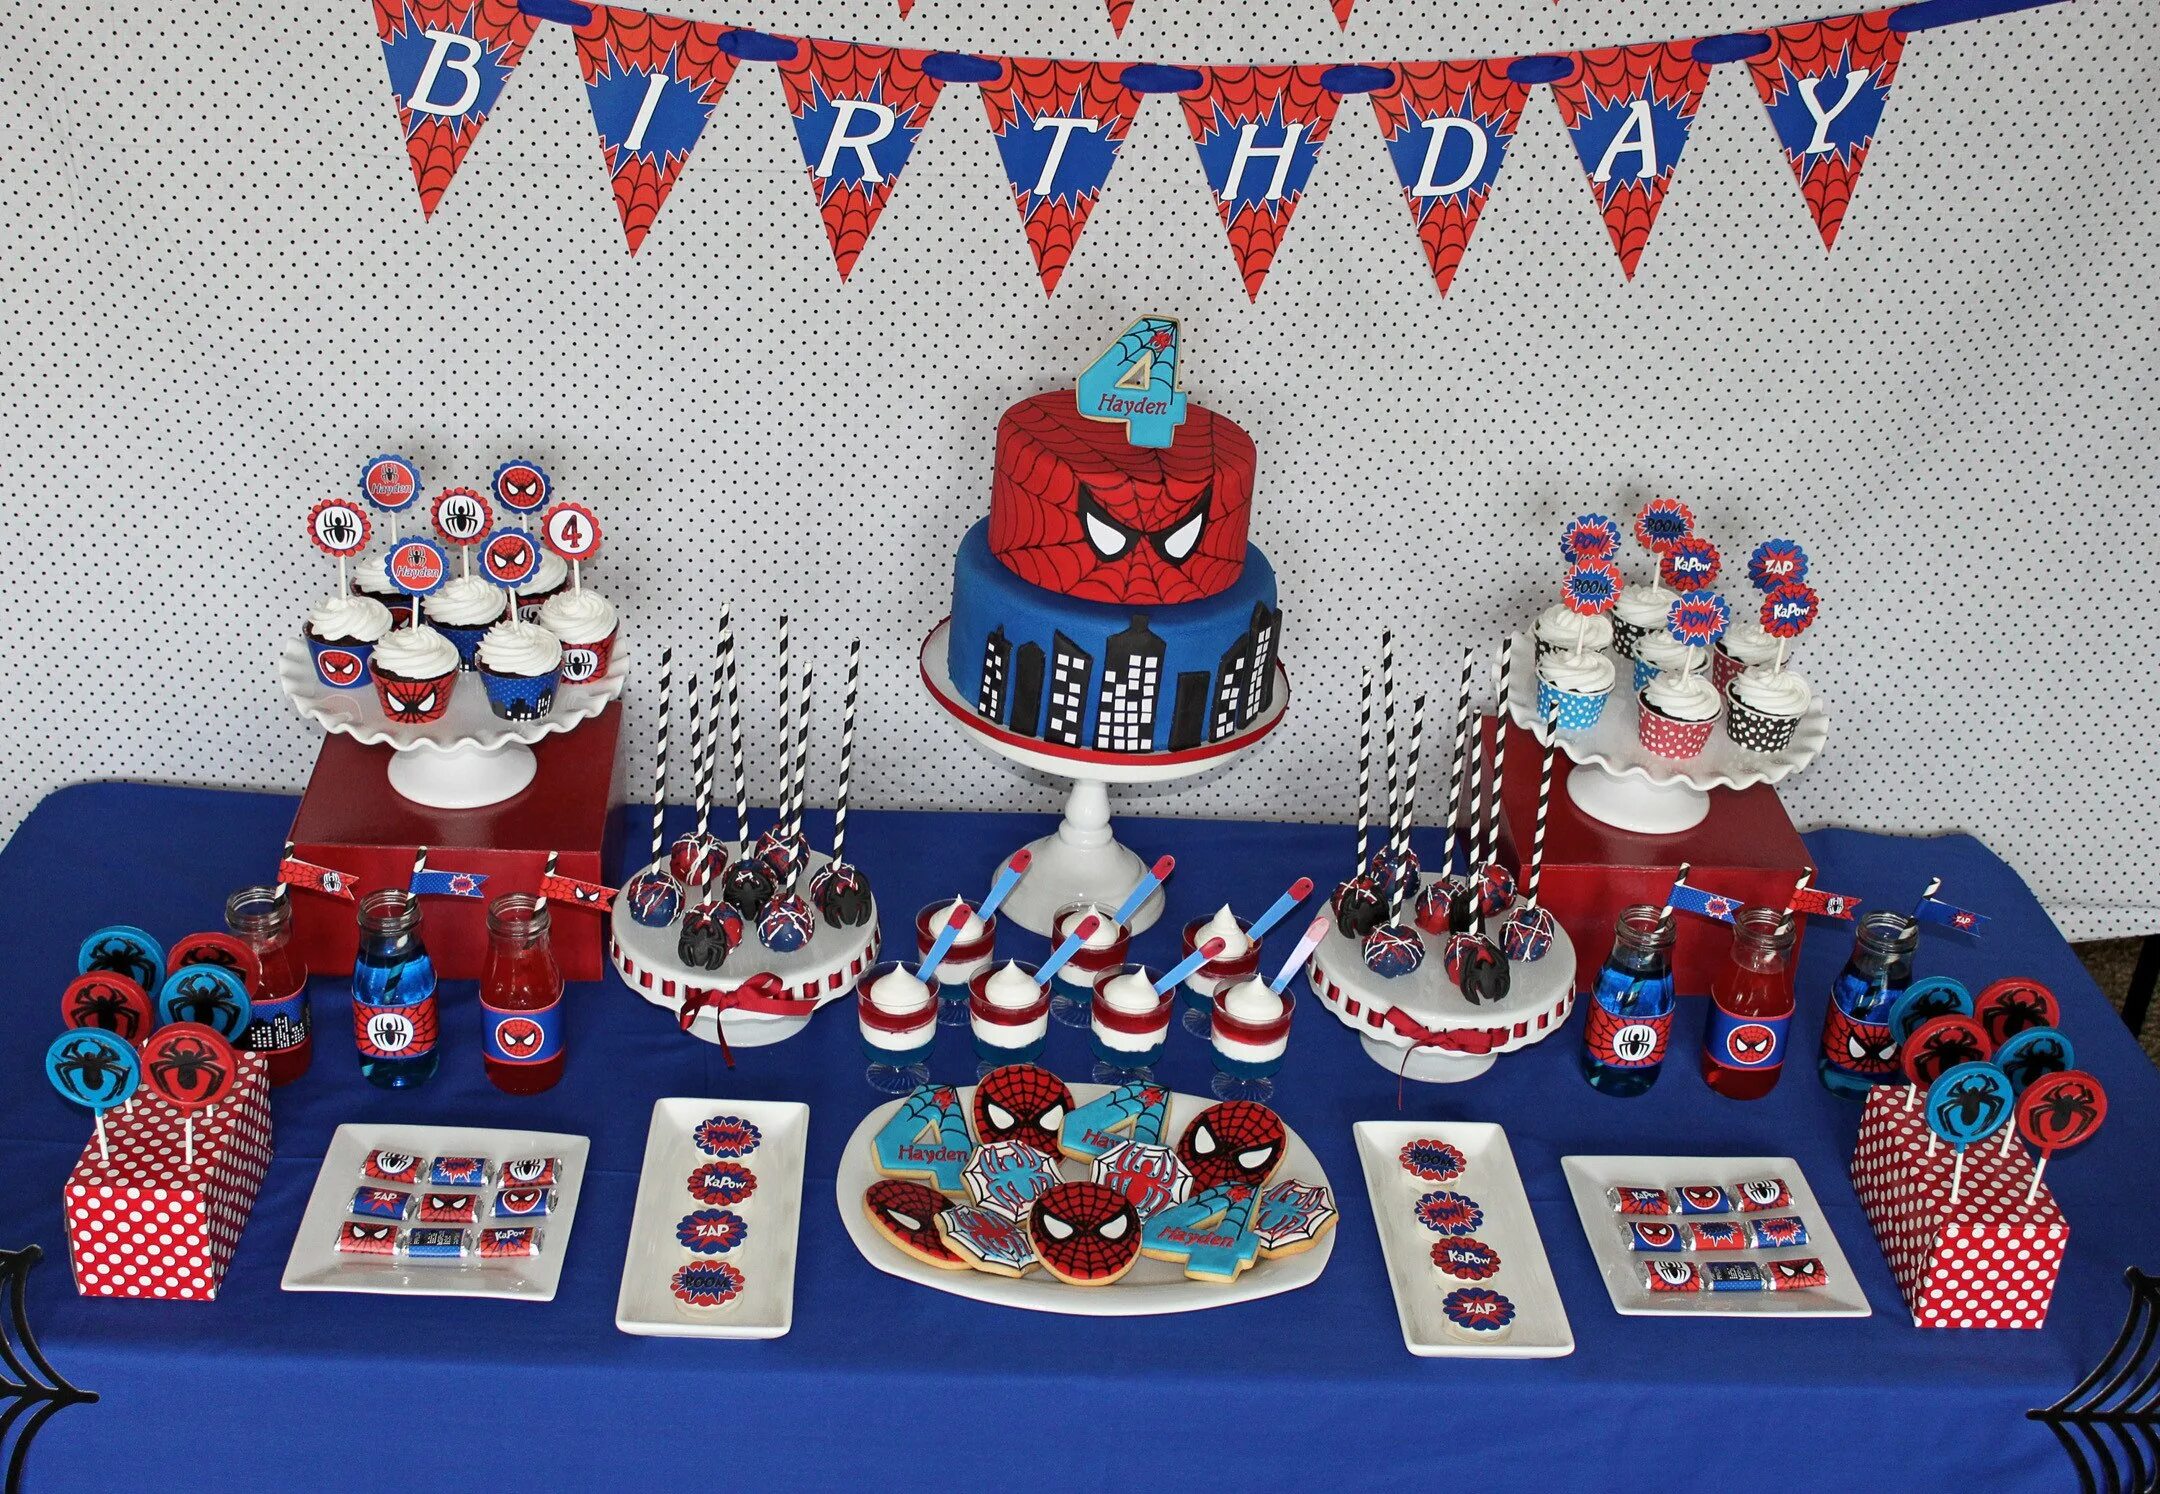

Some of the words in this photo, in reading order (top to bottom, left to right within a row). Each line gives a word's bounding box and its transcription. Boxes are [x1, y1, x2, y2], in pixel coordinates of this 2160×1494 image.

[1098, 393, 1167, 416] Hayden
[371, 482, 412, 496] Hayden
[560, 514, 583, 549] 4
[1647, 517, 1681, 532] BOOM
[1573, 531, 1610, 552] POW!
[396, 565, 440, 580] Hayden
[1674, 556, 1711, 573] KaPow
[1764, 559, 1794, 575] ZAP
[1574, 578, 1608, 595] BOOM
[1773, 603, 1811, 619] KaPow
[1680, 609, 1717, 631] POW!
[1956, 915, 1971, 925] ZAP
[707, 1130, 746, 1147] POW!
[898, 1144, 969, 1164] Hayden
[1413, 1151, 1452, 1167] BOOM
[703, 1174, 747, 1190] KaPow
[372, 1191, 398, 1202] ZAP
[1428, 1202, 1466, 1221] POW!
[695, 1223, 730, 1237] ZAP
[1157, 1225, 1235, 1248] Hayden
[1448, 1249, 1491, 1266] KaPow
[683, 1272, 730, 1289] BOOM
[1463, 1301, 1498, 1316] ZAP
